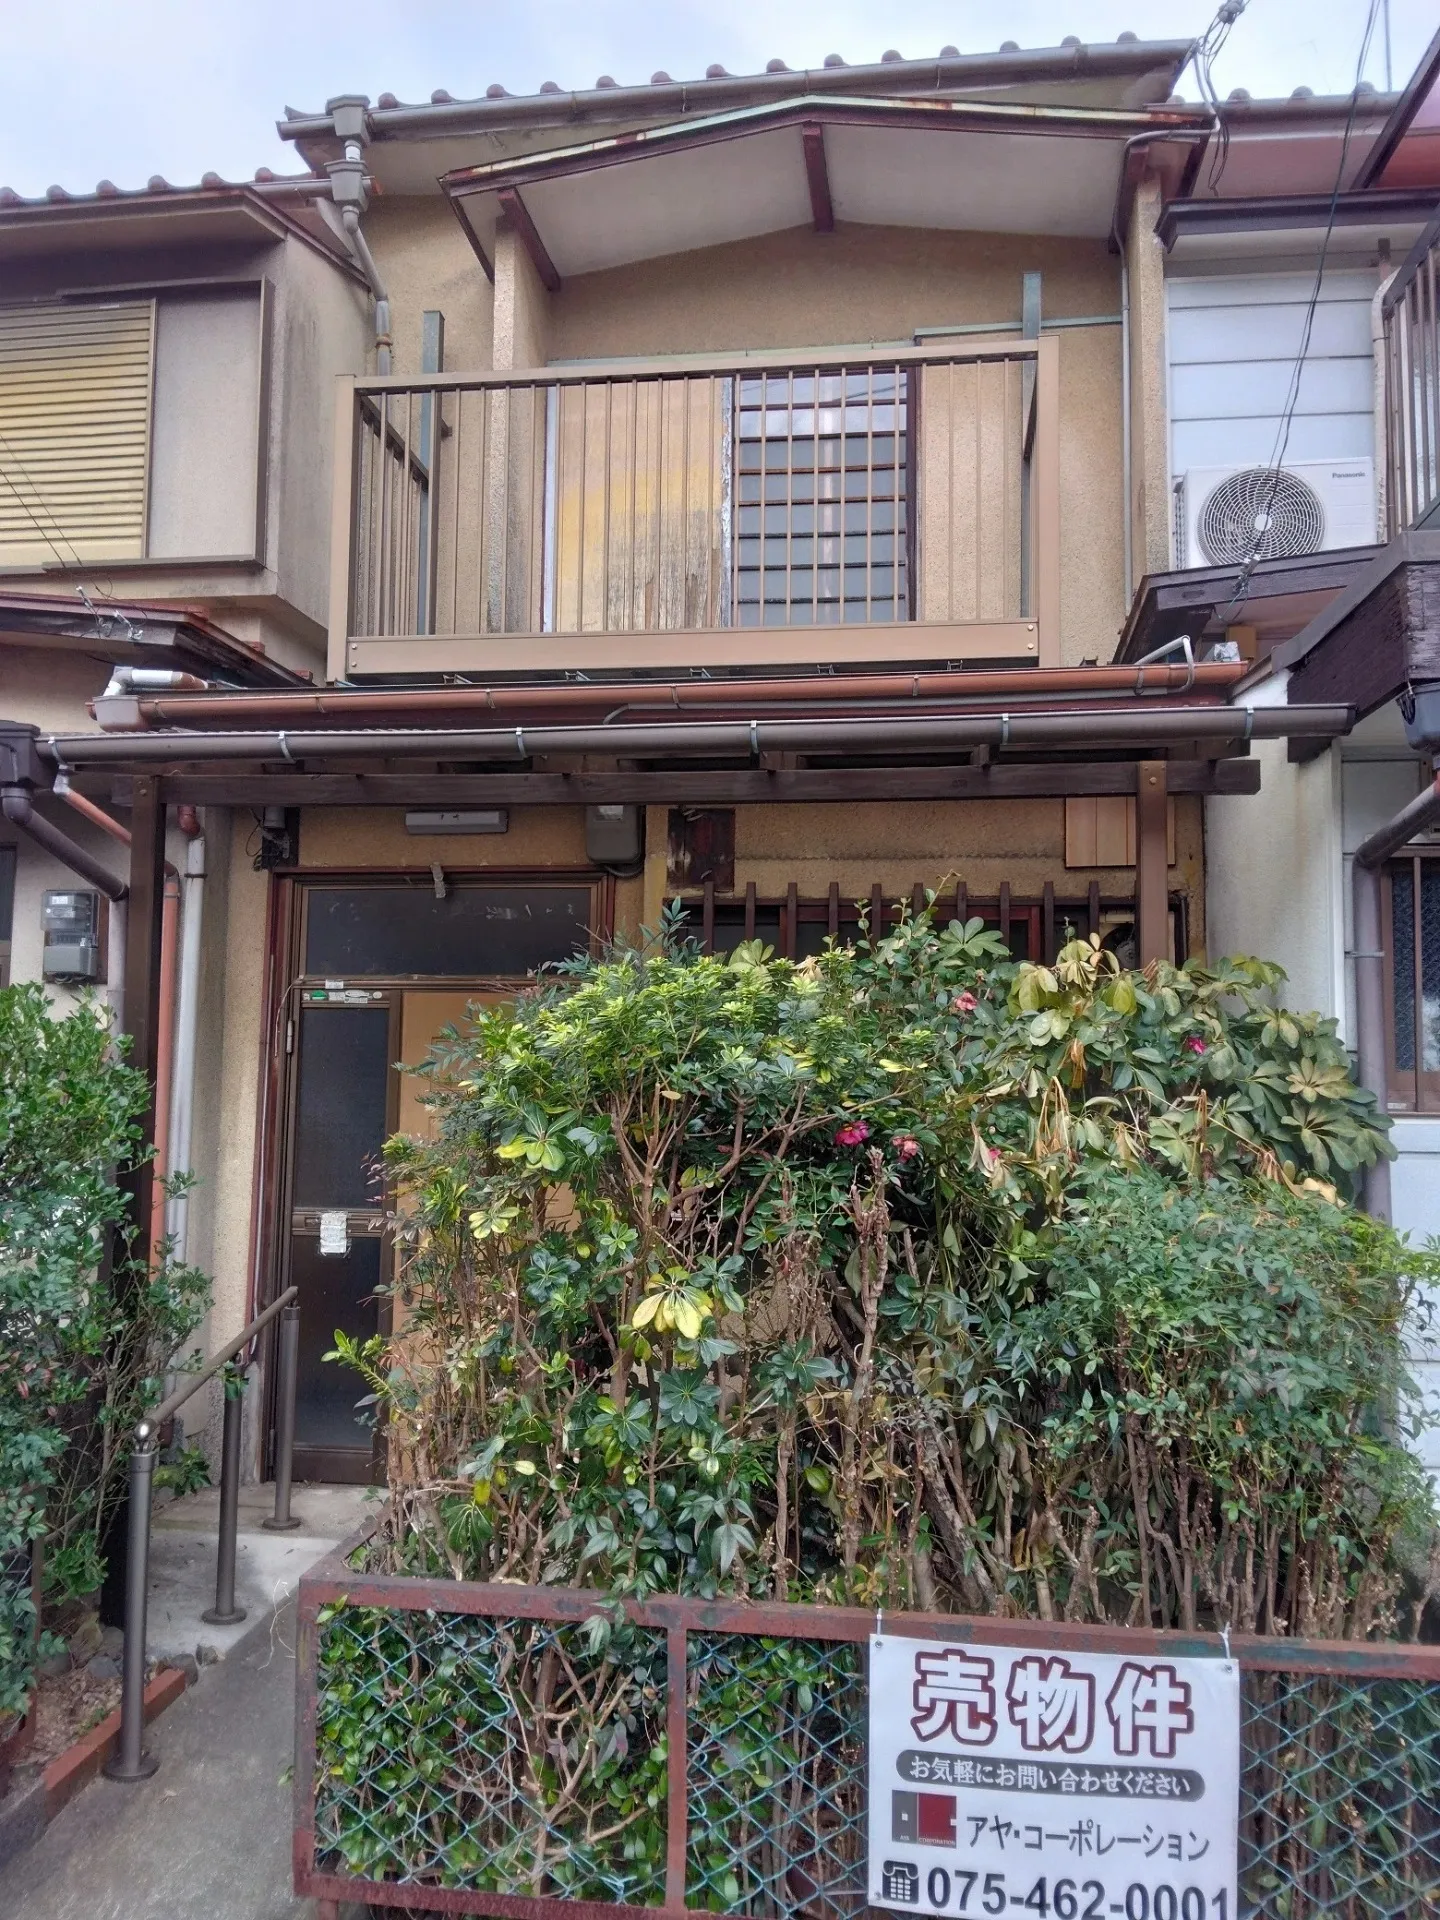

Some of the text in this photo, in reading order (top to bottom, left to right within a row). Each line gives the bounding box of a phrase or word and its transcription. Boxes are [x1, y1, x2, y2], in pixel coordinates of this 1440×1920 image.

[910, 1648, 1195, 1759] 売物件
[909, 1755, 1192, 1796] お気軽にお問い合わせください
[966, 1814, 1210, 1862] アヤ・コーポレーション
[926, 1866, 1229, 1920] 075-462-0001
